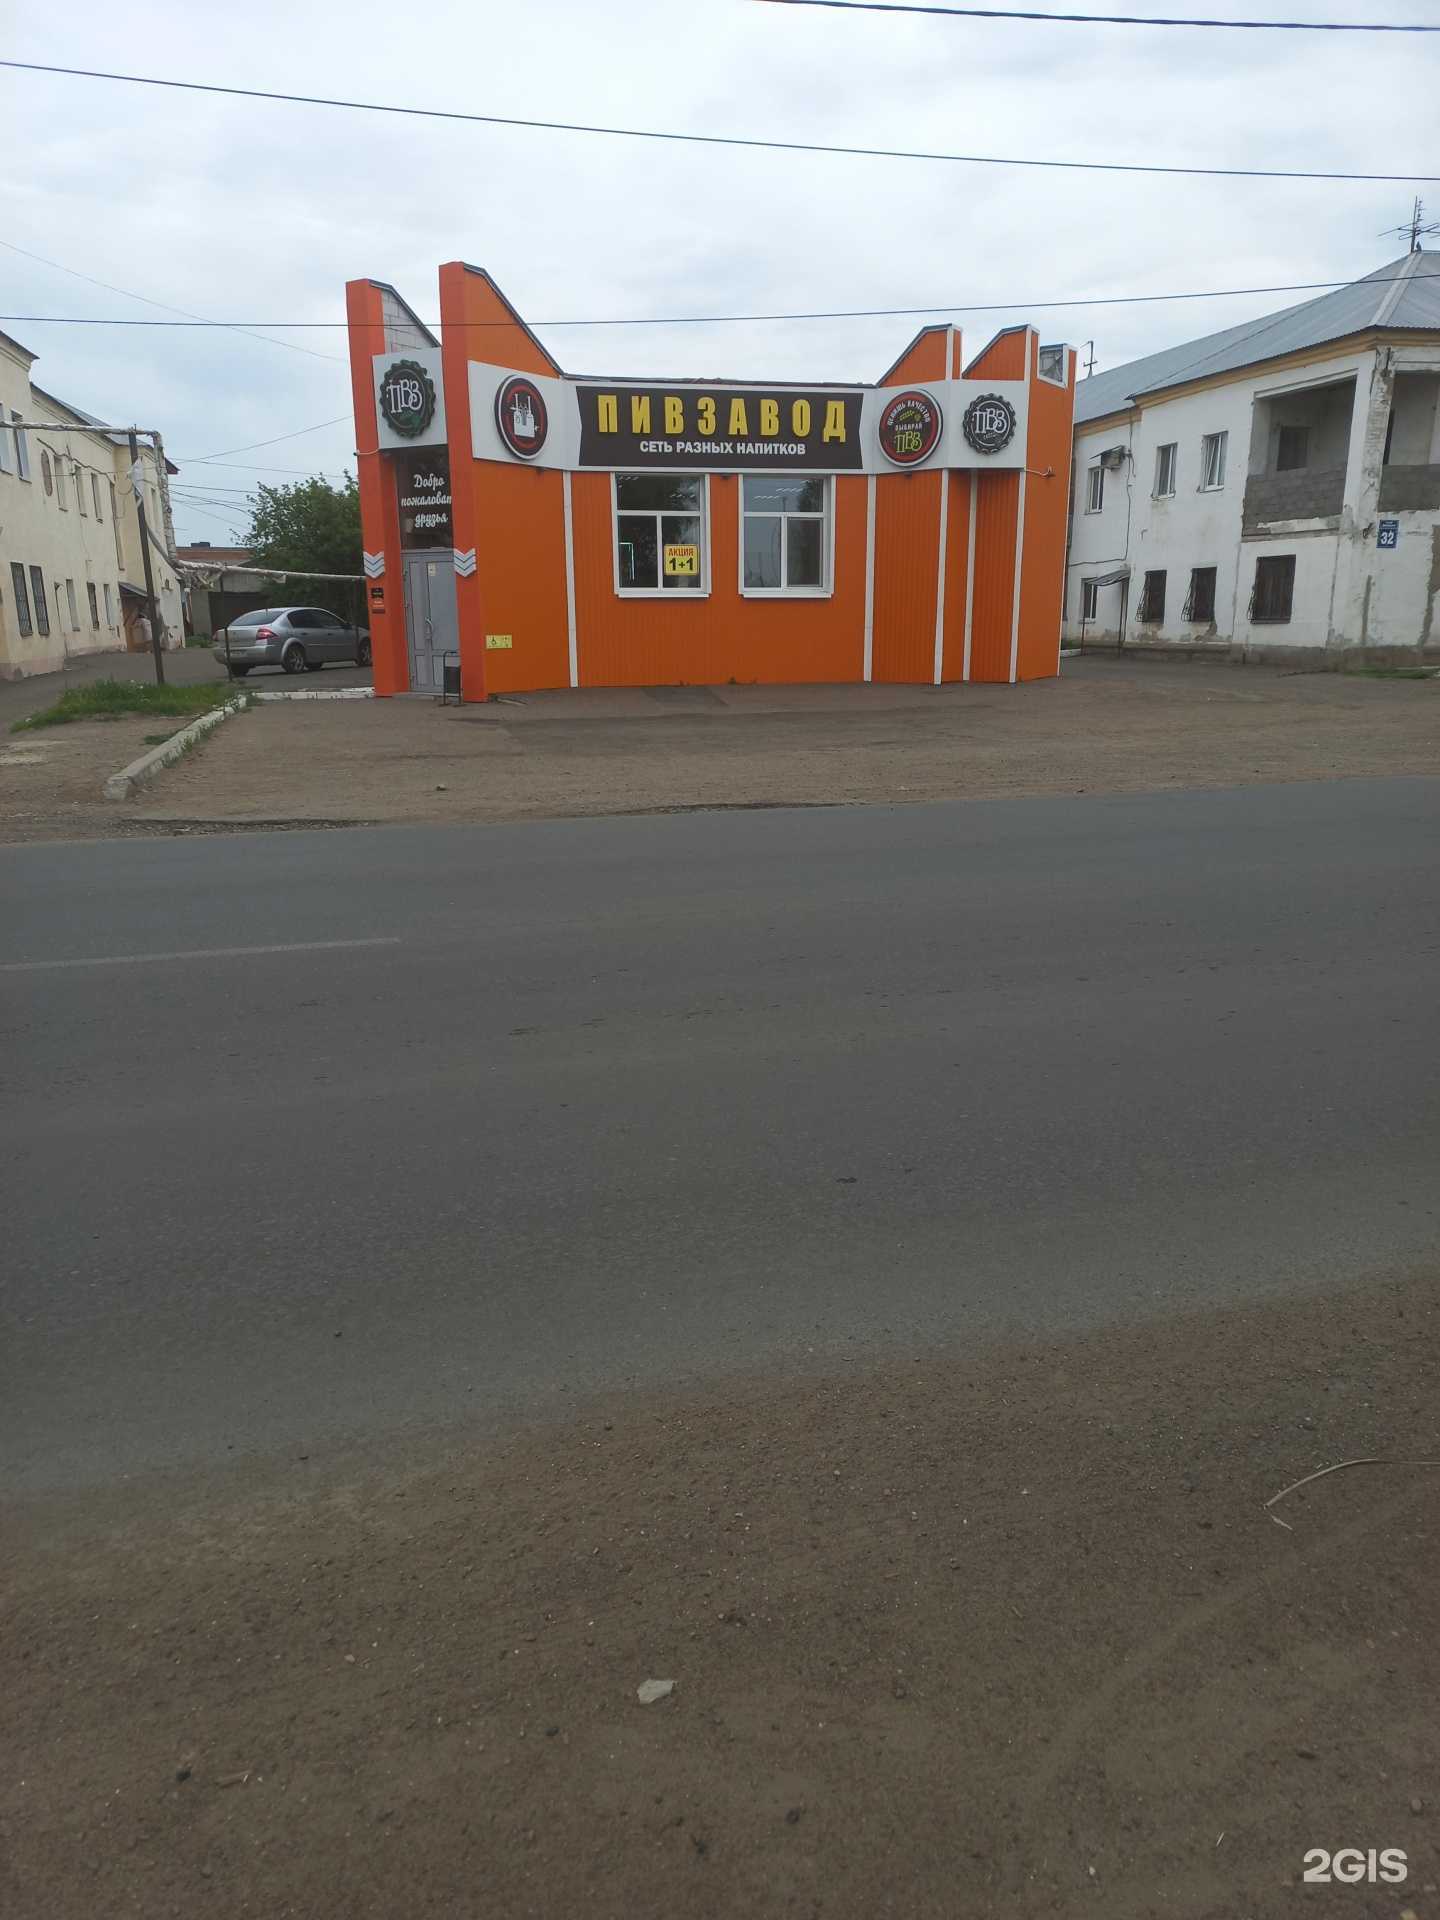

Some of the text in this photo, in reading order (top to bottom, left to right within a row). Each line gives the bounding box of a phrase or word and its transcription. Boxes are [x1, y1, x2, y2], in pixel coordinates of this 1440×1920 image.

[386, 380, 422, 413] ПВЗ
[597, 394, 846, 442] ПИВЗАВОД
[972, 407, 1008, 434] ПВЗ
[640, 441, 806, 455] СЕТЬ РАЗНЫХ НАПИТКОВ
[895, 431, 923, 453] ПВЗ
[414, 473, 446, 491] Добро
[401, 491, 452, 507] пожаловат
[415, 513, 449, 528] друзья
[1380, 531, 1394, 544] 32
[668, 547, 694, 557] АКЦИЯ
[668, 557, 694, 571] 1+1
